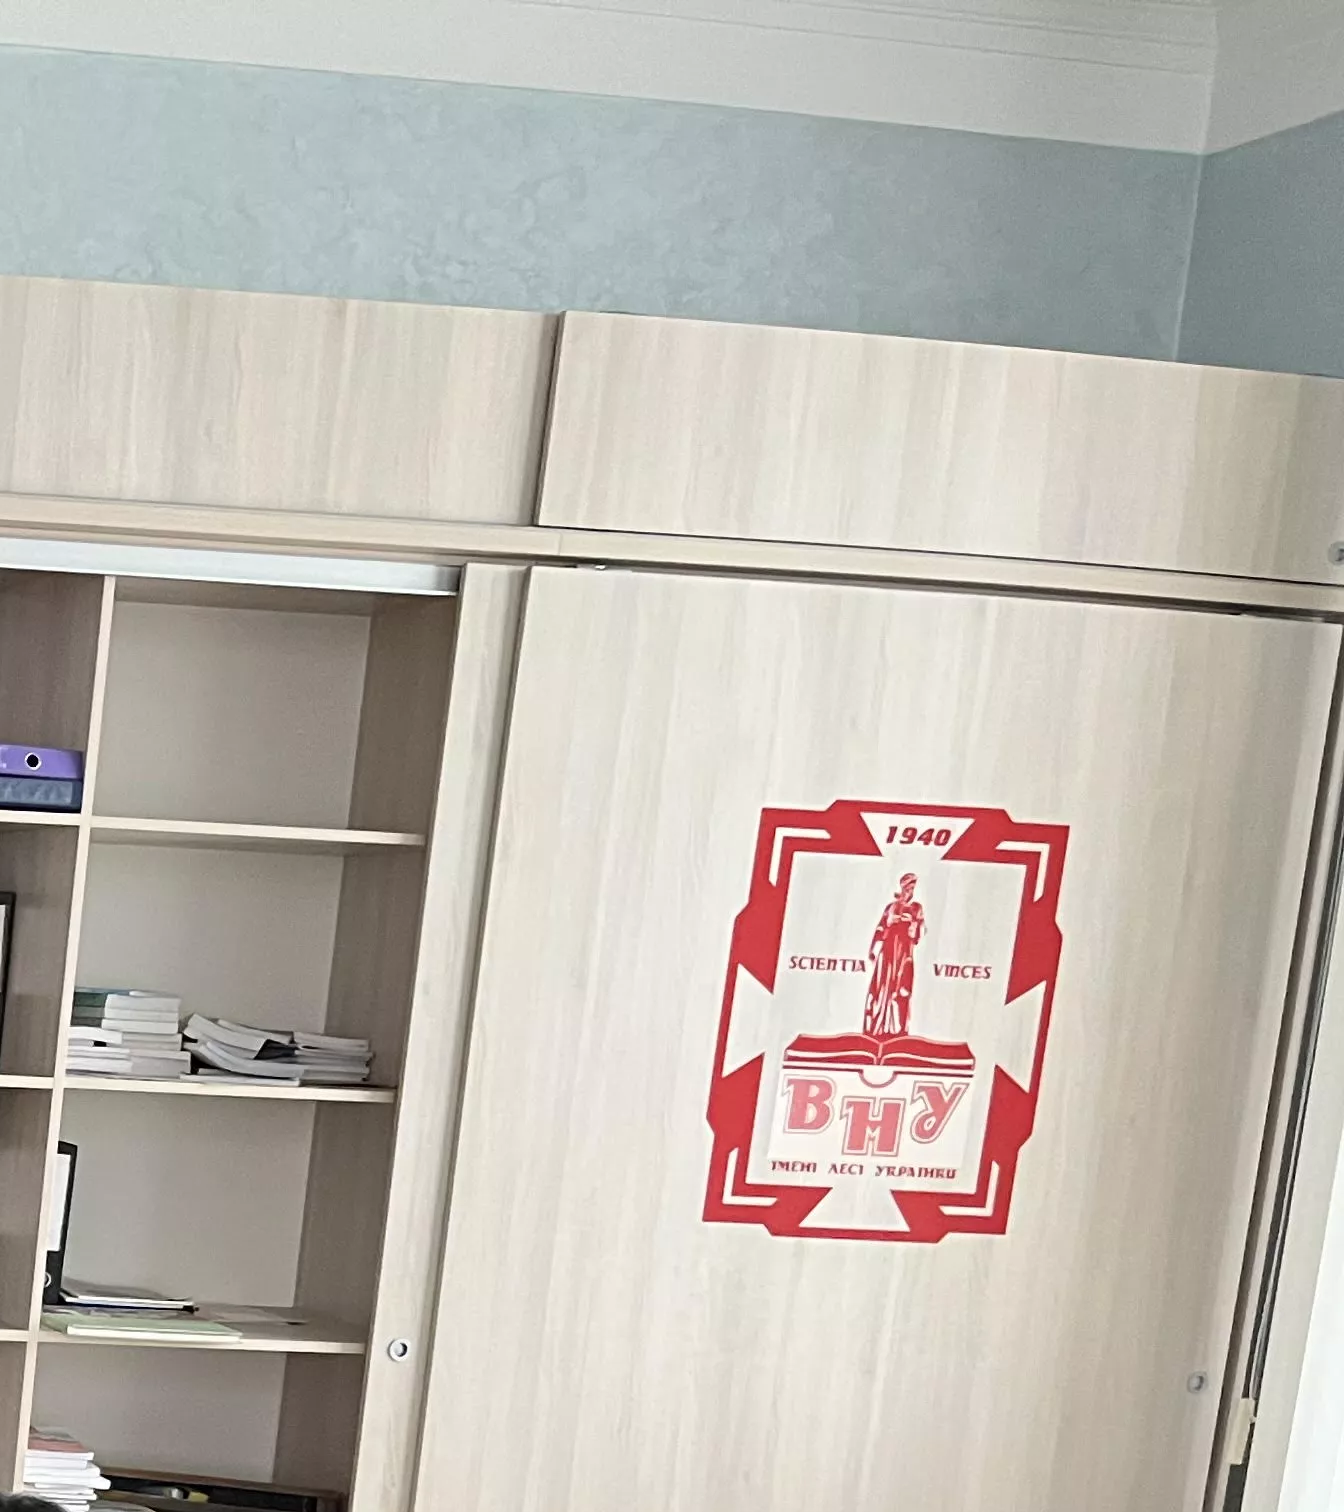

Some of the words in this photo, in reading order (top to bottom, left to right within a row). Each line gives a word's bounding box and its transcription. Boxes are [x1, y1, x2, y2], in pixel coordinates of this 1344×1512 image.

[885, 825, 951, 847] 1940
[788, 955, 867, 973] SCIENTIA
[932, 963, 992, 980] VINCES
[782, 1075, 970, 1157] ВНУ
[770, 1159, 818, 1174] ІМЕНІ
[827, 1162, 864, 1176] ЛЕСІ
